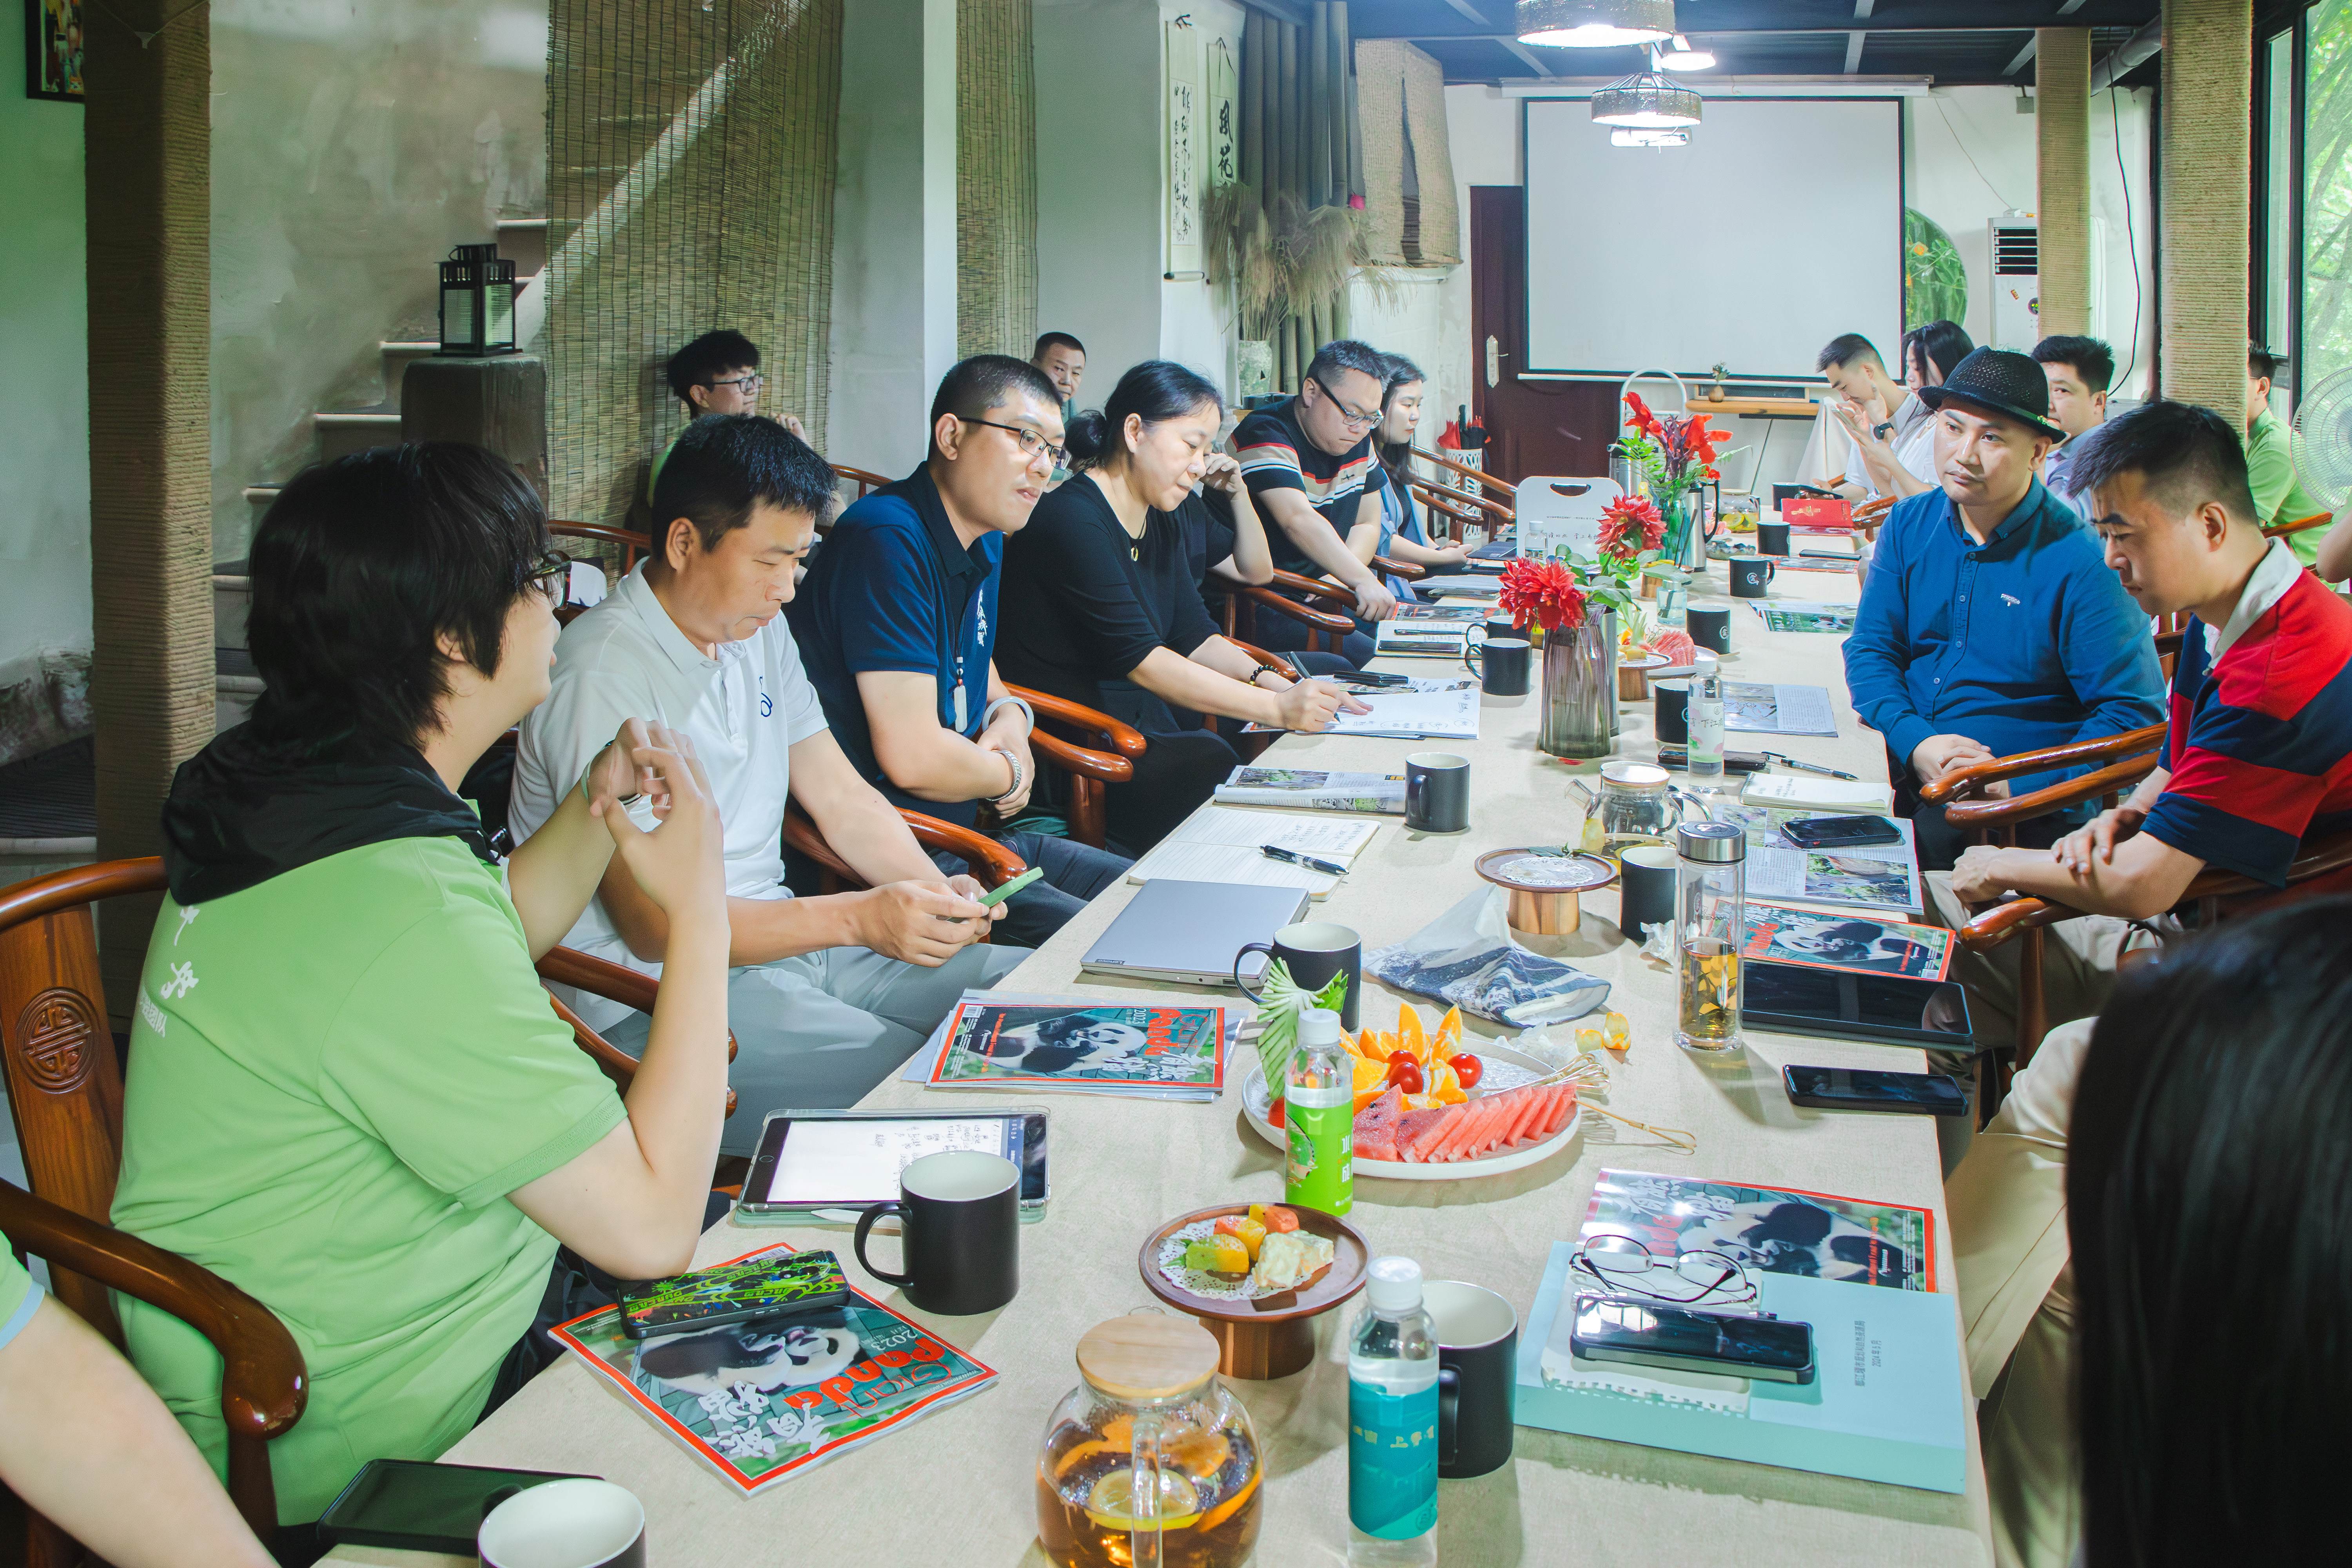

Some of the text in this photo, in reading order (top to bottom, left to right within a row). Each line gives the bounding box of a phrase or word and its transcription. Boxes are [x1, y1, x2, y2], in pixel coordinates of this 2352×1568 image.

[1132, 1008, 1147, 1024] 2023
[1145, 1008, 1182, 1055] Panda
[871, 1329, 918, 1351] 2023
[783, 1337, 945, 1409] Panda
[833, 1362, 952, 1418] Giant
